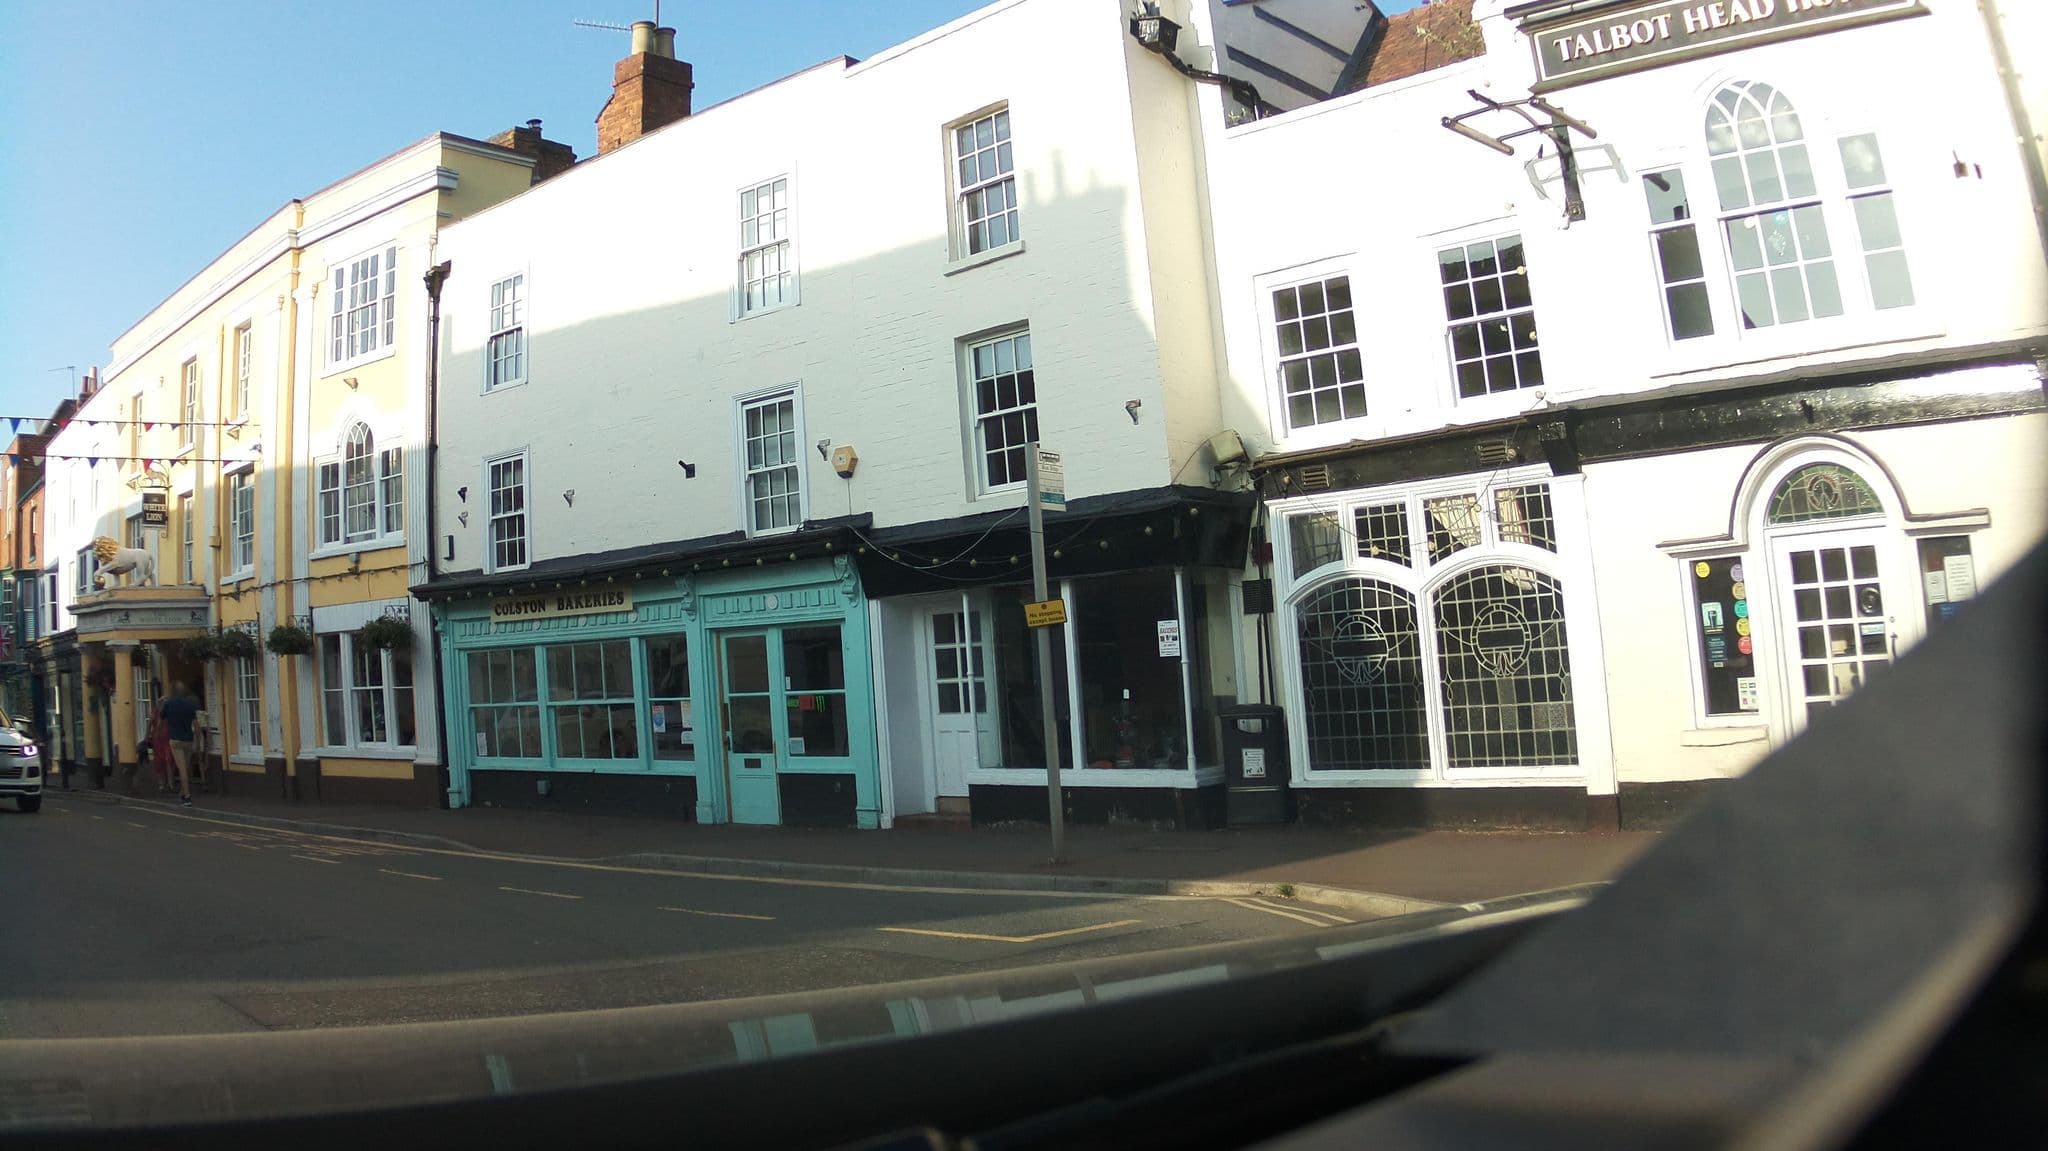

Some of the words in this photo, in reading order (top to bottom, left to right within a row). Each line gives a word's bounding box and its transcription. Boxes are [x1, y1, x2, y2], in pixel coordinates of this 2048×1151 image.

[1553, 13, 1672, 62] TALBOT
[1683, 0, 1776, 34] HEAD
[143, 503, 167, 512] WHITE
[145, 512, 163, 521] LION
[494, 600, 546, 616] COLSTON
[557, 591, 625, 611] BAKERIES
